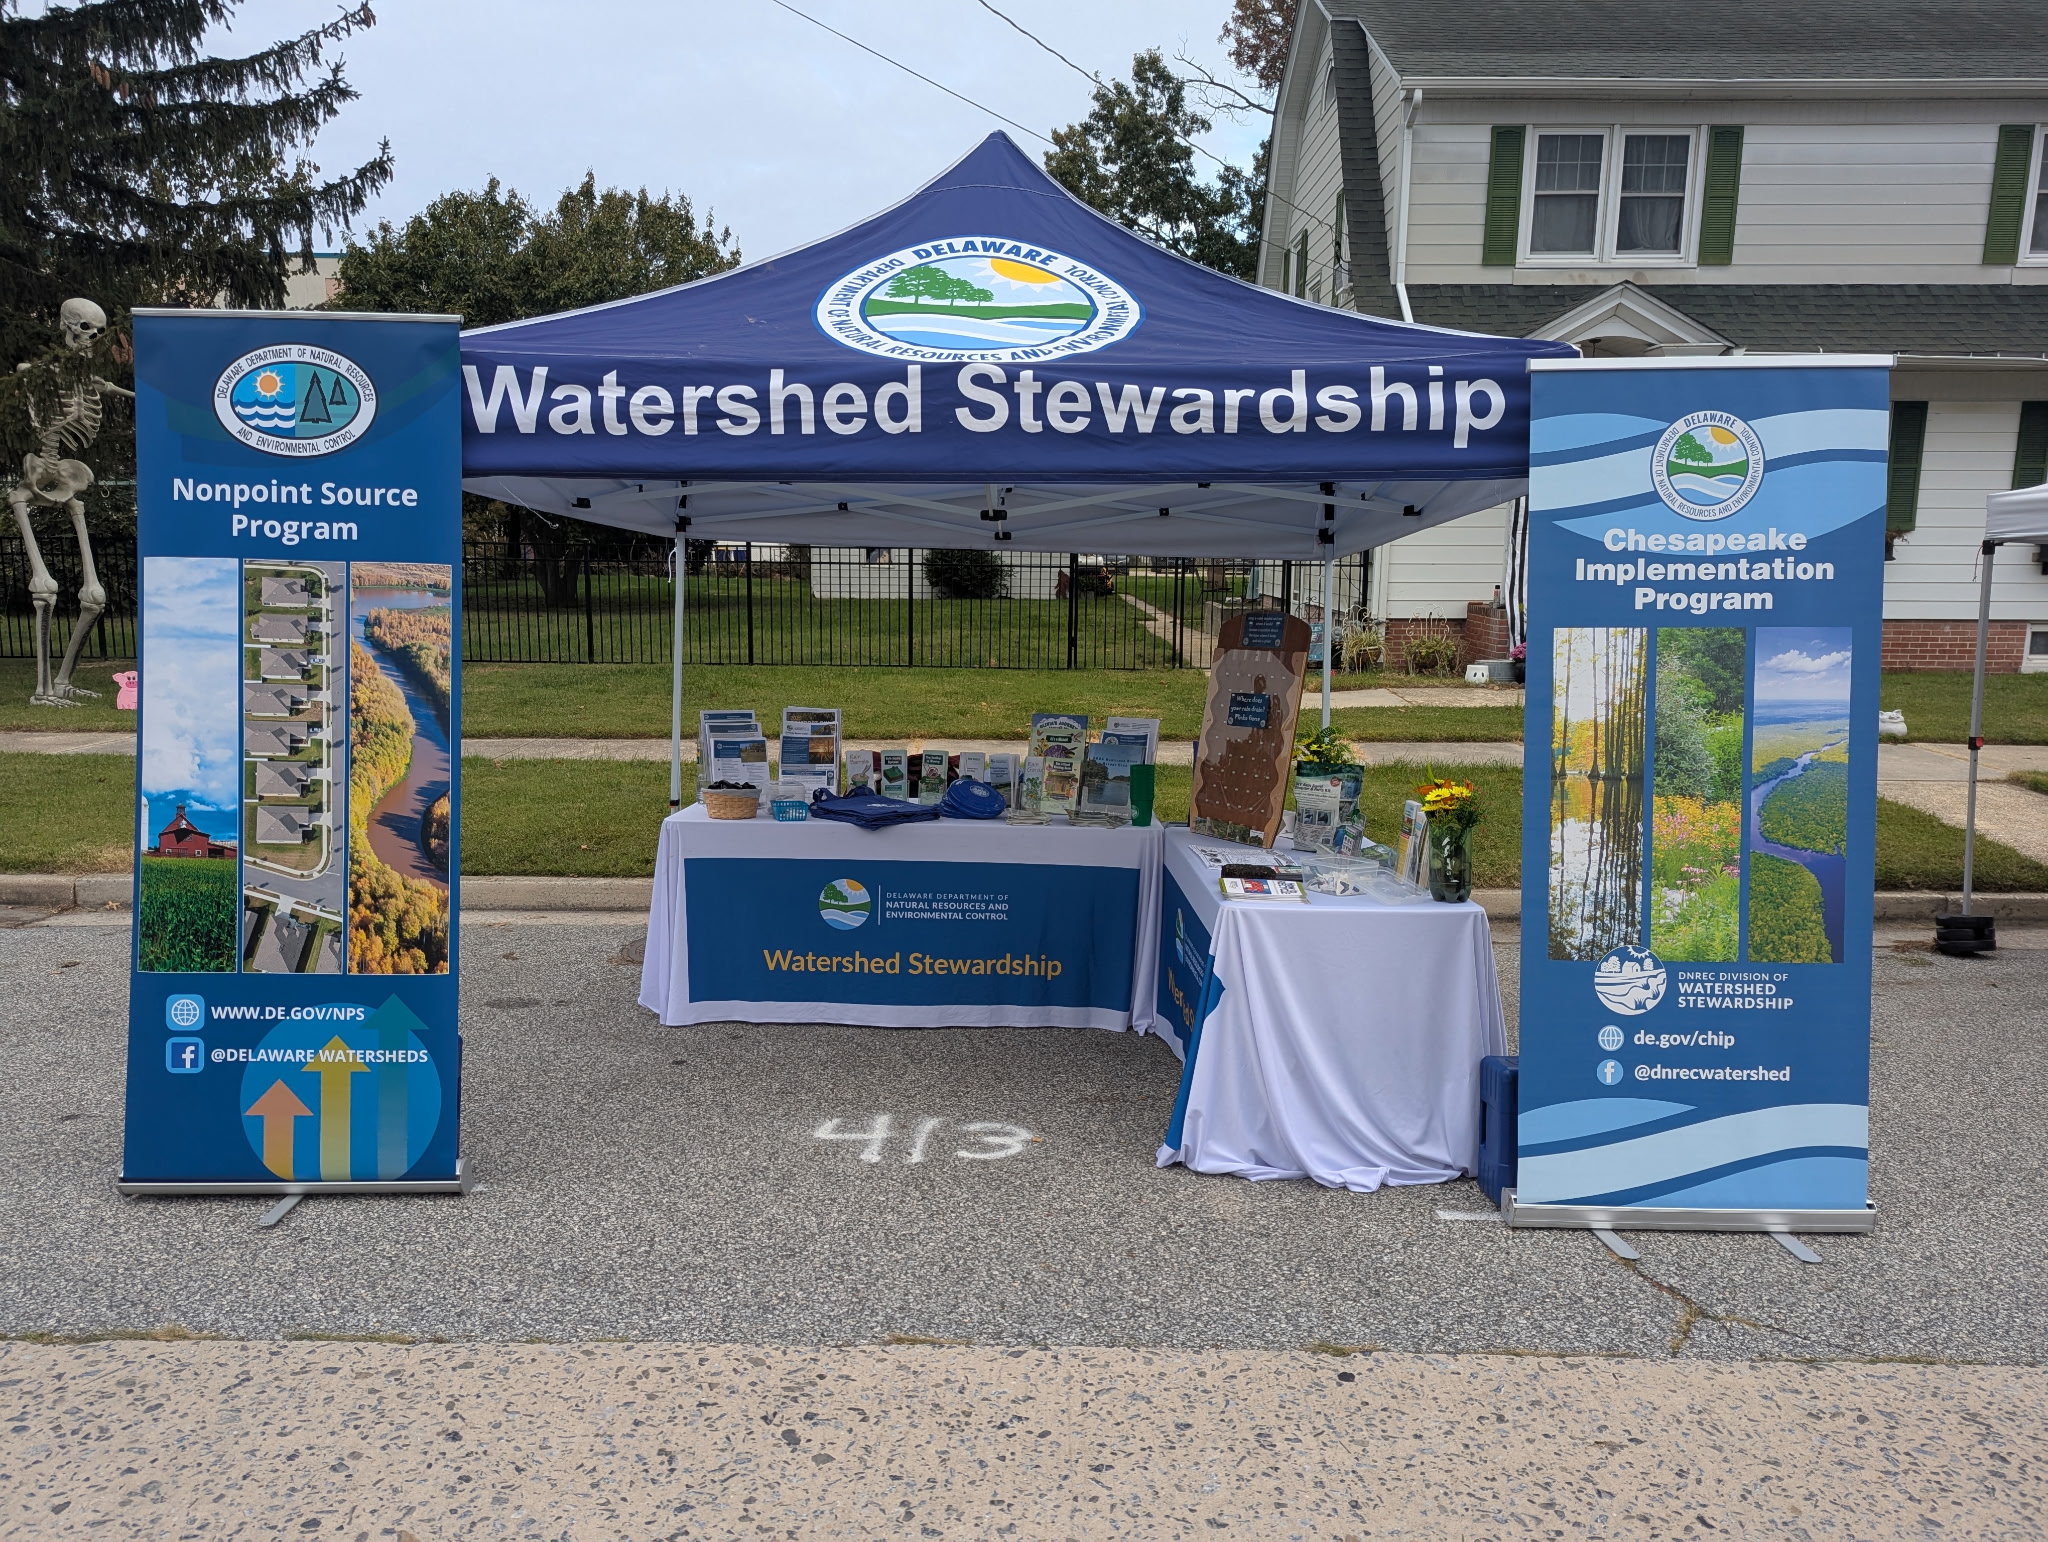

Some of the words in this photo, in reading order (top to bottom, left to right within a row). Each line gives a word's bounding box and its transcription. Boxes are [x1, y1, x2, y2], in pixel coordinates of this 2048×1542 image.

[912, 240, 1058, 266] DELAWARE
[829, 258, 905, 307] DEPARTMENT
[1064, 264, 1121, 299] CONTROL
[830, 319, 888, 349] NATURAL
[884, 345, 1003, 361] RESOURCES
[1010, 348, 1053, 361] AND
[217, 364, 245, 399] DELAWARE
[245, 347, 292, 367] DEPARTMENT
[297, 348, 306, 358] OF
[310, 350, 342, 369] NATURAL
[345, 365, 374, 402] RESOURCES
[462, 364, 922, 436] Watershed
[954, 363, 1506, 448] Stewardship
[1683, 412, 1737, 428] DELAWARE
[236, 426, 252, 441] AND
[256, 435, 321, 453] ENVIRONMENTAL
[324, 429, 356, 450] CONTROL
[1655, 427, 1680, 467] DEPARTMENT
[1740, 427, 1760, 456] CONTROL
[172, 478, 313, 508] Nonpoint
[320, 483, 418, 507] Source
[1656, 479, 1677, 506] NATURAL
[1732, 457, 1760, 508] ENVIRONMENTAL
[1677, 502, 1717, 517] RESOURCES
[1718, 505, 1733, 516] AND
[232, 514, 358, 545] Program
[1603, 528, 1808, 556] Chesapeake
[1575, 557, 1835, 586] Implementation
[1634, 588, 1774, 615] Program
[885, 911, 964, 920] ENVIRONMENTAL
[965, 912, 1008, 921] CONTROL
[886, 901, 929, 910] NATURAL
[932, 902, 986, 911] RESOURCES
[988, 902, 1009, 911] AND
[763, 950, 900, 974] Watershed
[908, 953, 1062, 981] Stewardship
[1678, 971, 1715, 981] DNREC
[1720, 972, 1769, 981] DIVISION
[1773, 973, 1789, 982] OF
[1678, 982, 1776, 995] WATERSHED
[211, 1006, 365, 1021] WWW.DE.GOV/NPS
[1678, 996, 1794, 1010] STEWARDSHIP
[1633, 1030, 1735, 1049] de.gov/chip
[210, 1048, 315, 1063] @DELAWARE
[318, 1049, 428, 1063] WATERSHEDS
[1634, 1064, 1790, 1082] @dnrecwatershed
[814, 1114, 1032, 1163] 413
